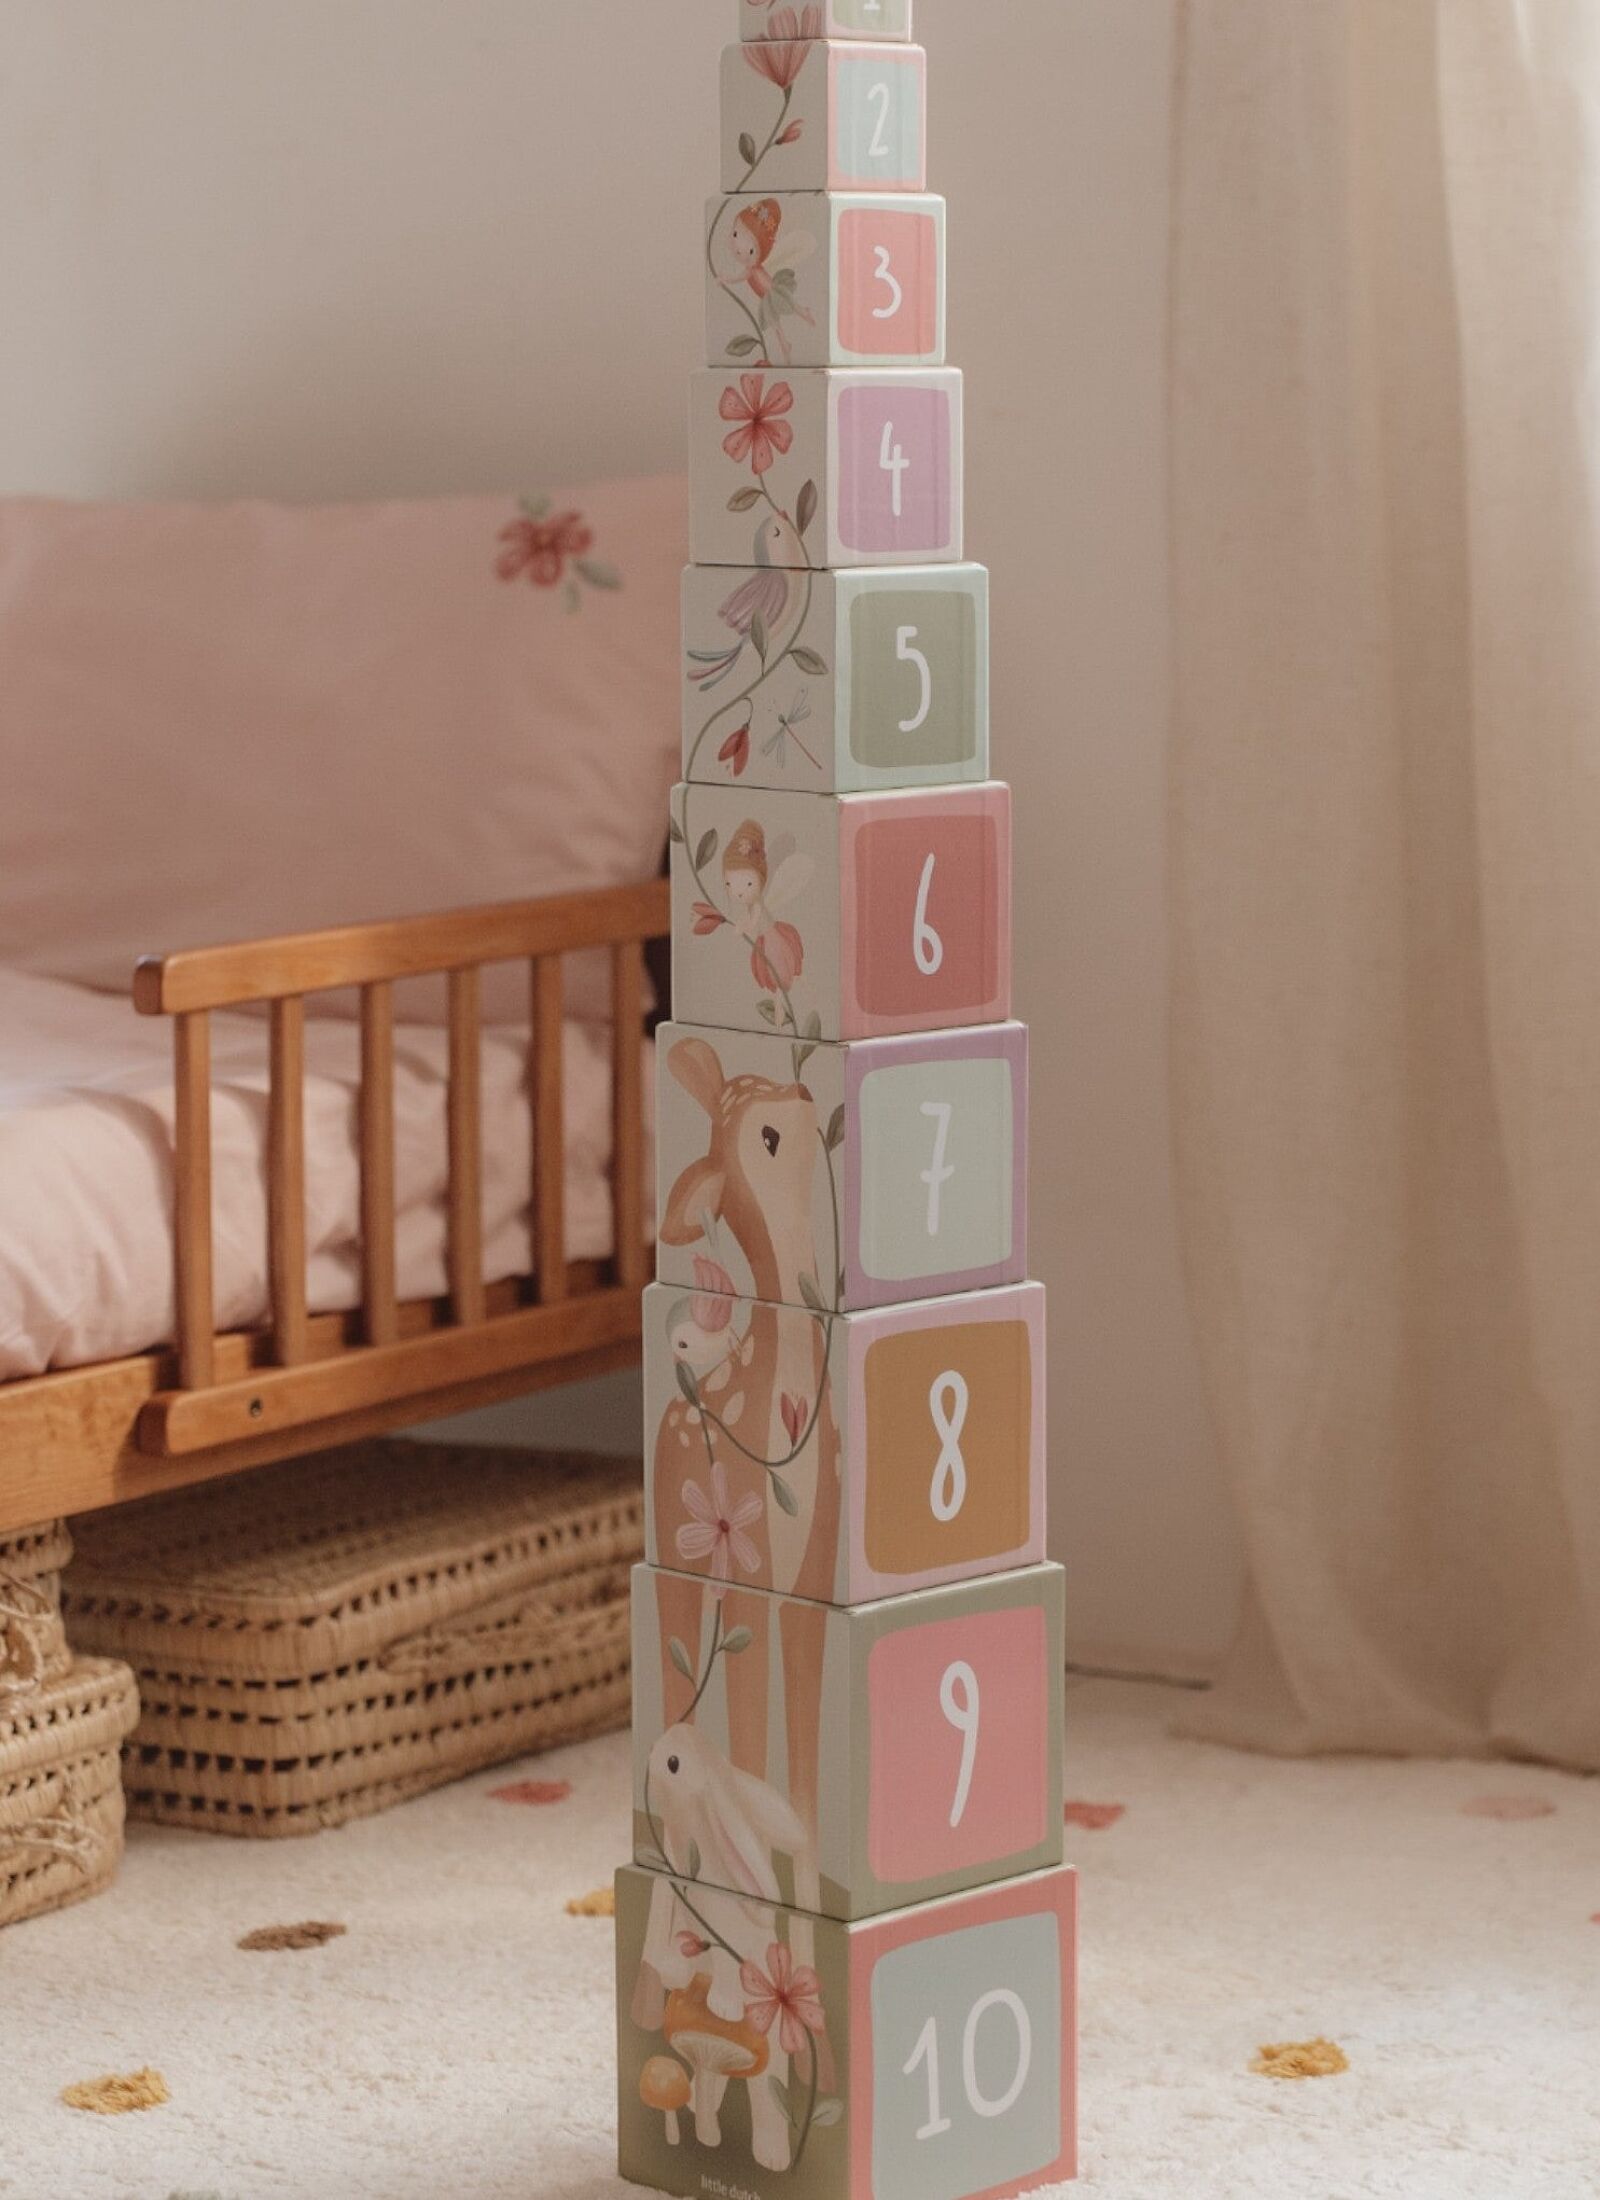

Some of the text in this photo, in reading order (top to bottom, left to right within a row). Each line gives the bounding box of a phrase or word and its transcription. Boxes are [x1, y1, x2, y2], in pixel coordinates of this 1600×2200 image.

[868, 83, 890, 157] 2
[872, 245, 902, 319] 3
[879, 421, 911, 517] 4
[895, 625, 932, 732] 5
[912, 852, 944, 976] 6
[919, 1101, 955, 1236] 7
[929, 1369, 969, 1522] 8
[939, 1660, 980, 1828] 9
[902, 1988, 1032, 2141] 10
[701, 2174, 728, 2196] little
